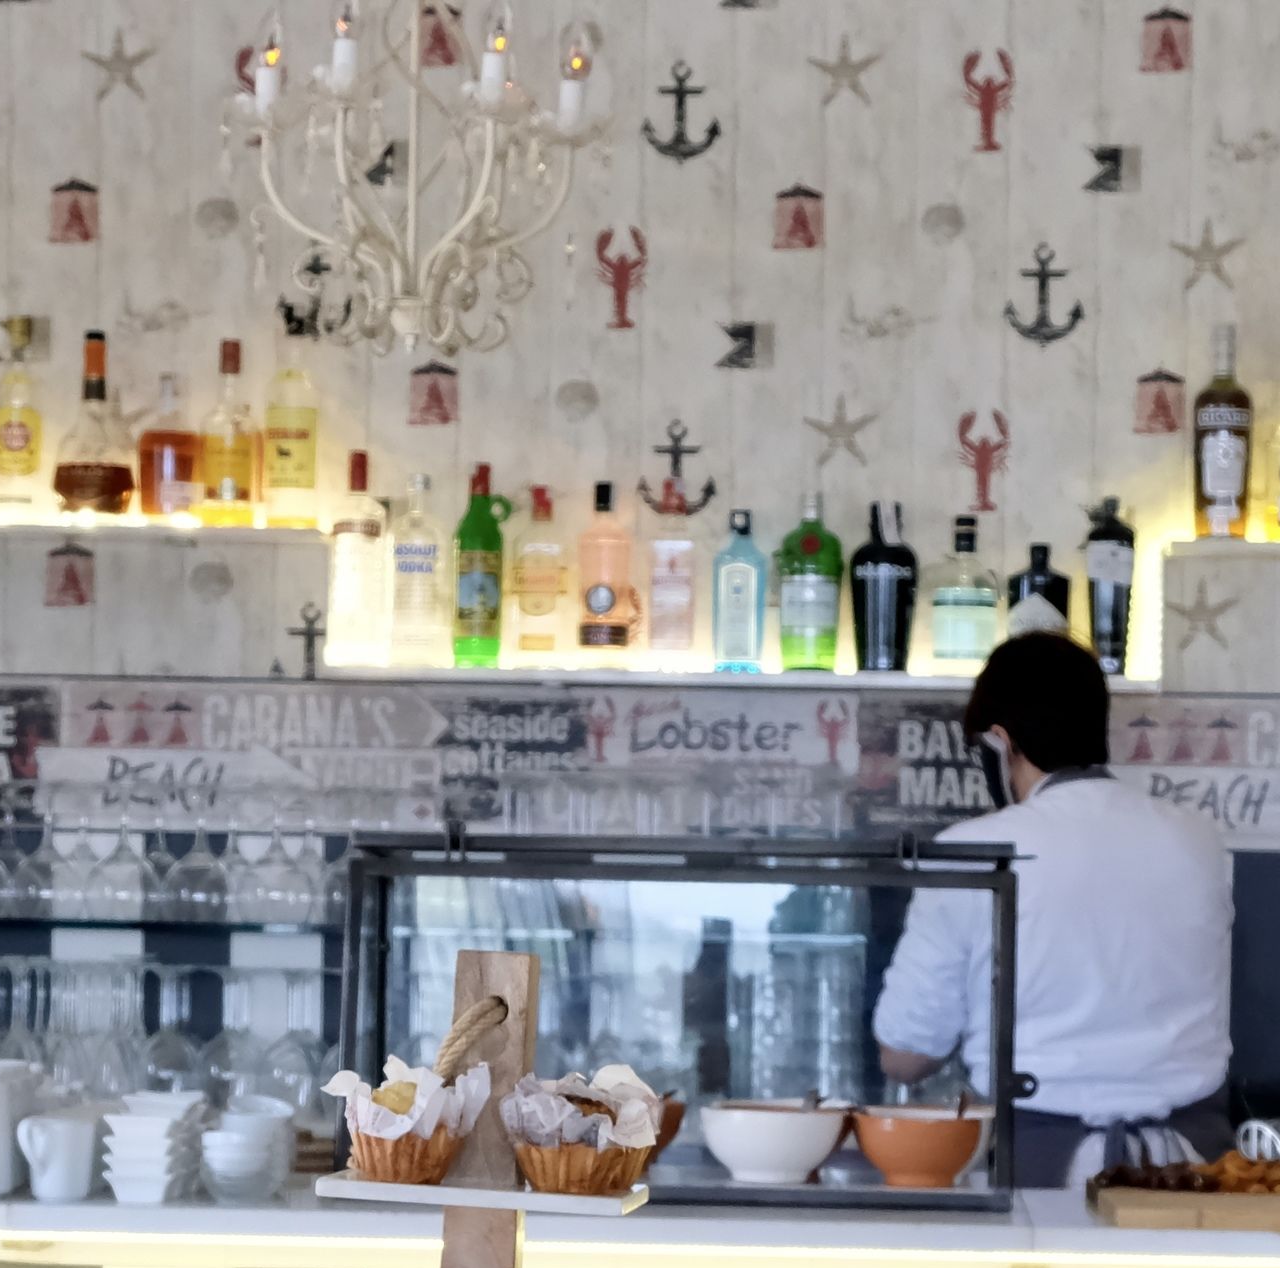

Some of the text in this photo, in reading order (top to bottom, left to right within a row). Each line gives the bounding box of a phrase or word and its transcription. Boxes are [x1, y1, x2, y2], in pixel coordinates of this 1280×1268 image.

[1200, 412, 1249, 423] RICARD
[454, 708, 569, 743] seaside
[629, 706, 803, 754] Lobster
[1149, 772, 1271, 831] BEACH
